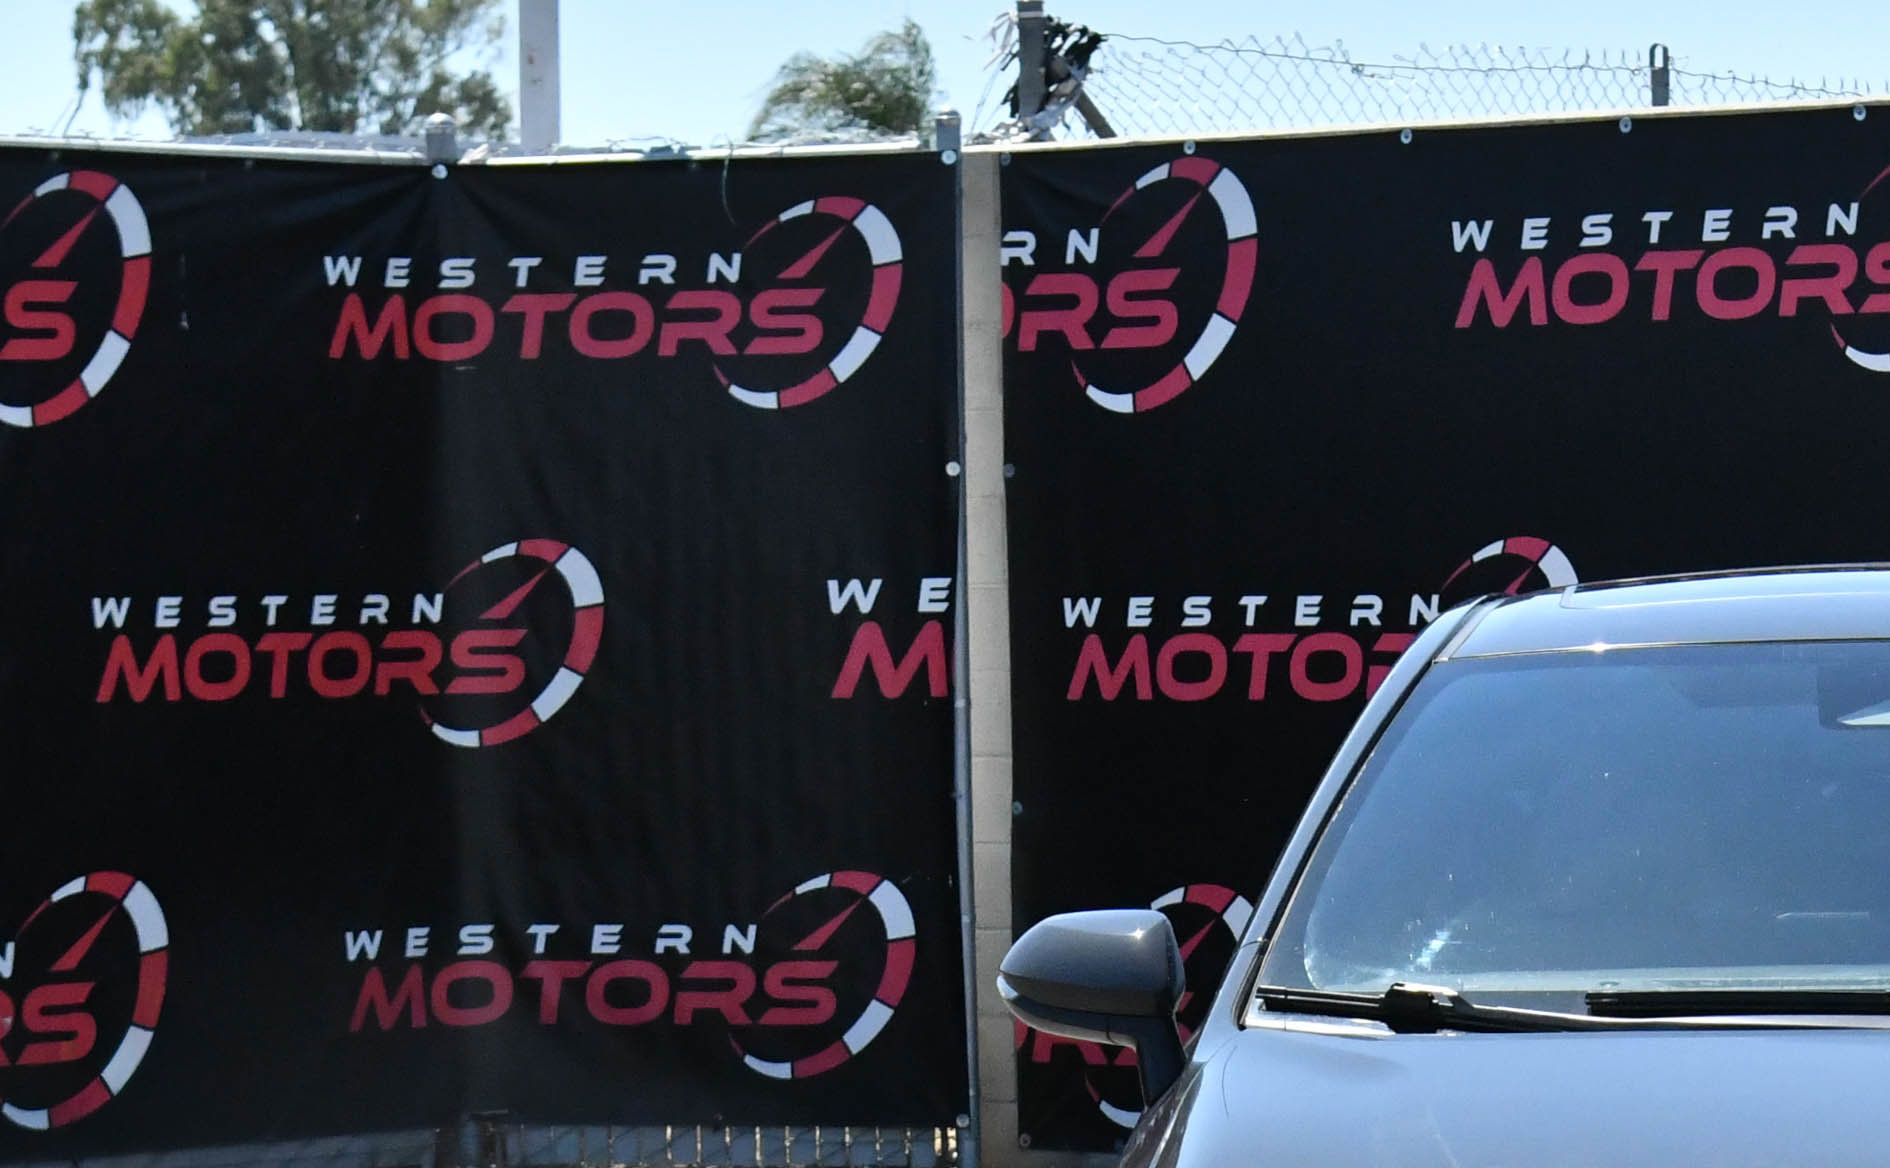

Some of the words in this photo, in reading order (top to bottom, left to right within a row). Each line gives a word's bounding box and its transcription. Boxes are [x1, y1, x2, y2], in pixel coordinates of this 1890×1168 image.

[1452, 203, 1858, 252] WESTERN
[325, 254, 741, 287] WESTERN
[330, 288, 823, 360] MOTORS
[1003, 269, 1178, 350] RS
[93, 594, 443, 628] WESTERN
[828, 578, 951, 614] WE
[1064, 594, 1440, 628] WESTERN
[97, 630, 525, 702] MOTORS
[834, 621, 947, 698] M
[346, 925, 756, 960] WESTERN
[350, 960, 837, 1031] MOTORS
